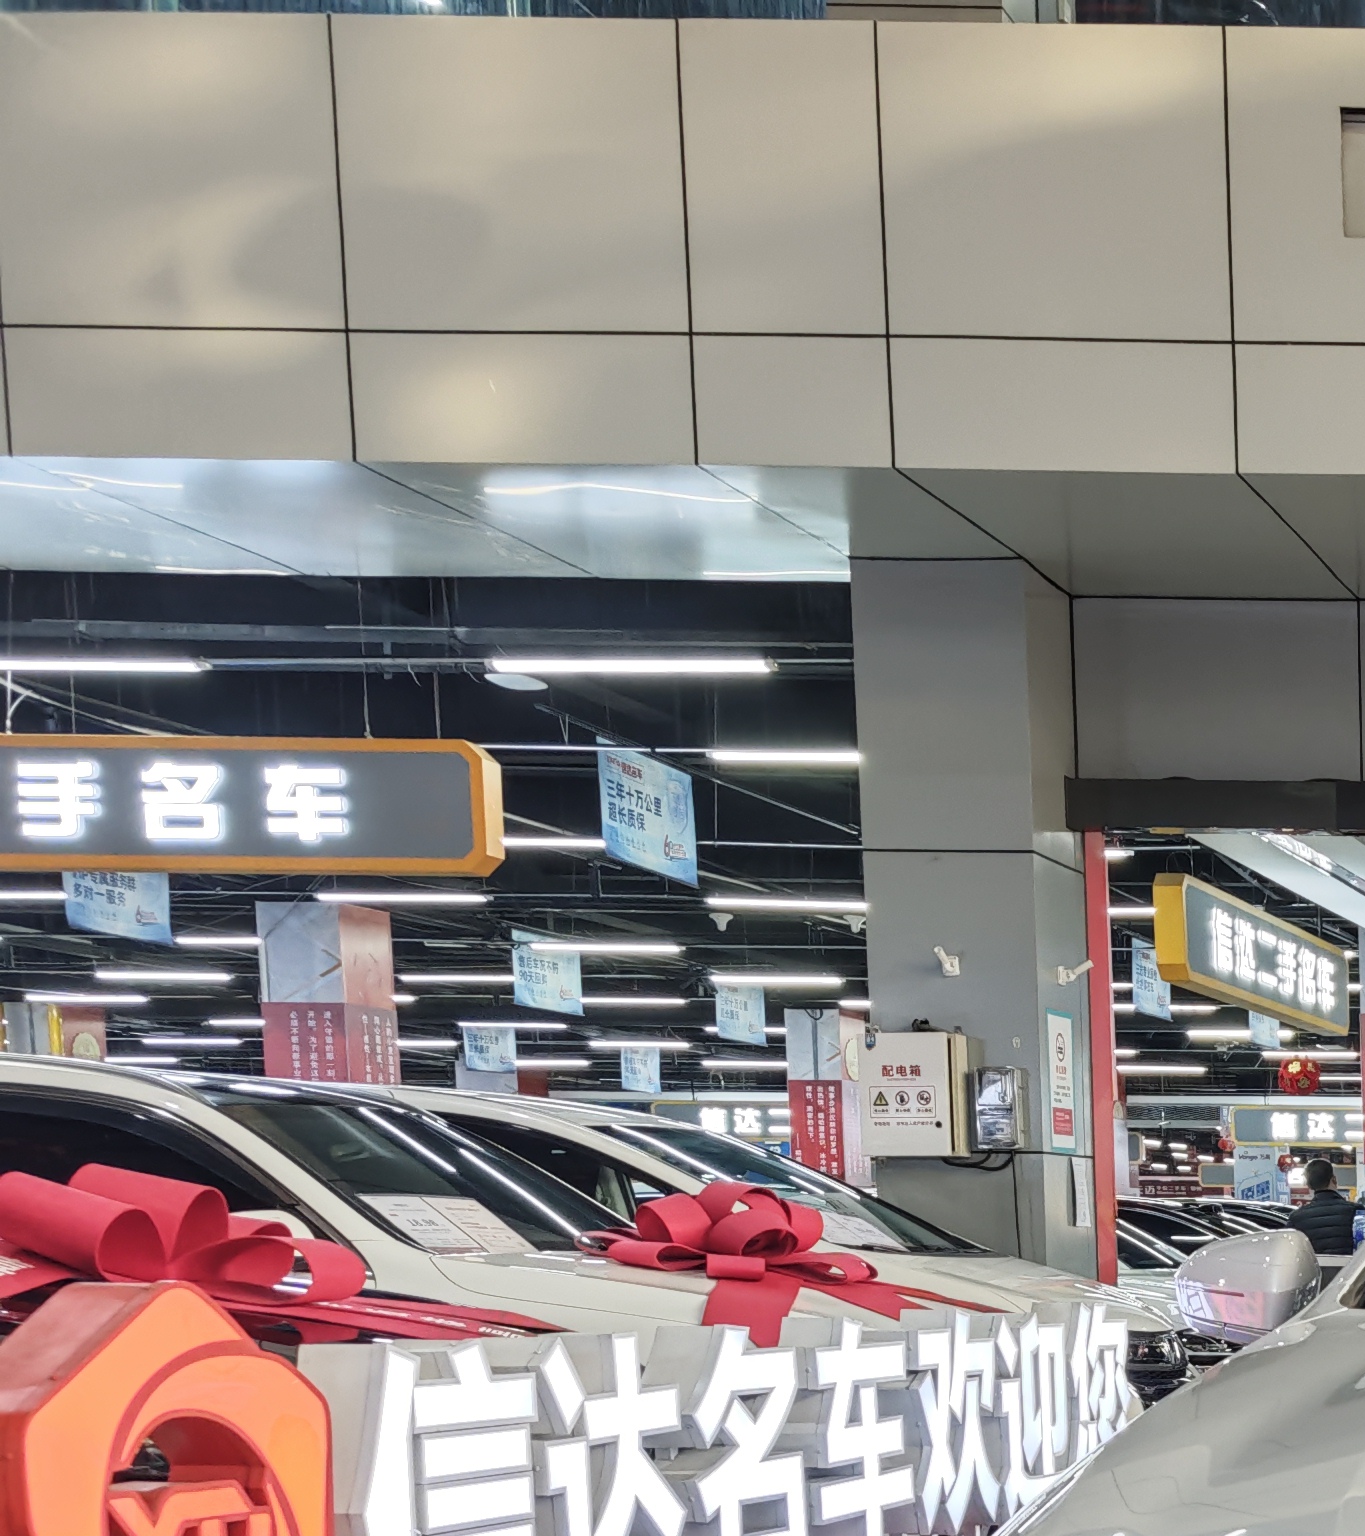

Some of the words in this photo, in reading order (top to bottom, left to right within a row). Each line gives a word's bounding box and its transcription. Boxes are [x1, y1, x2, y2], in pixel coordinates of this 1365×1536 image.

[14, 760, 348, 842] 手名车
[606, 779, 662, 817] 三年十万公里
[607, 802, 646, 832] 超长质保
[1211, 904, 1336, 1014] 信达二手名车
[881, 1064, 921, 1077] 配电箱
